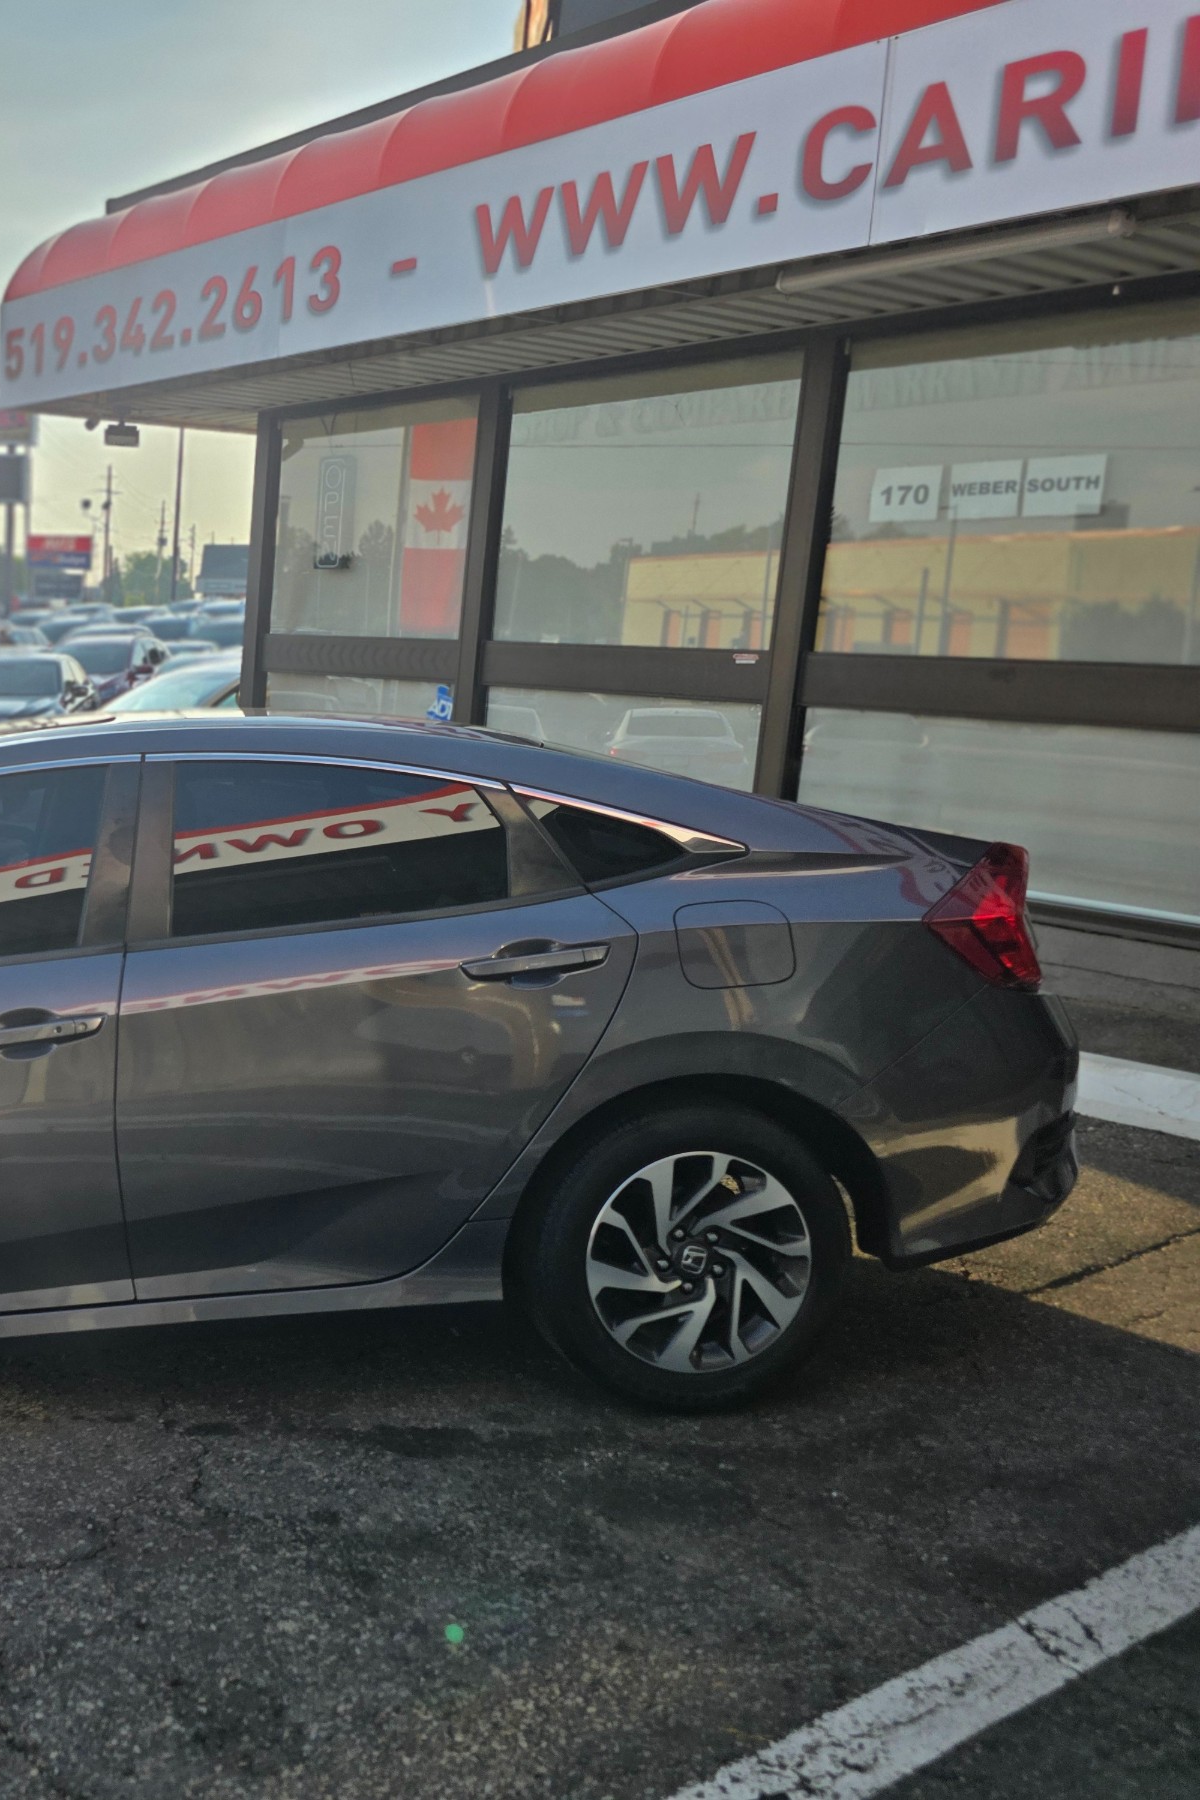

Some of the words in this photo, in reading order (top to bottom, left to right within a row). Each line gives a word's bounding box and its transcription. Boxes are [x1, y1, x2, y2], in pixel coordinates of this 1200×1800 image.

[4, 245, 342, 382] 519.342.2613
[880, 484, 930, 506] 170
[952, 480, 1017, 497] WEBER
[1027, 475, 1100, 493] SOUTH
